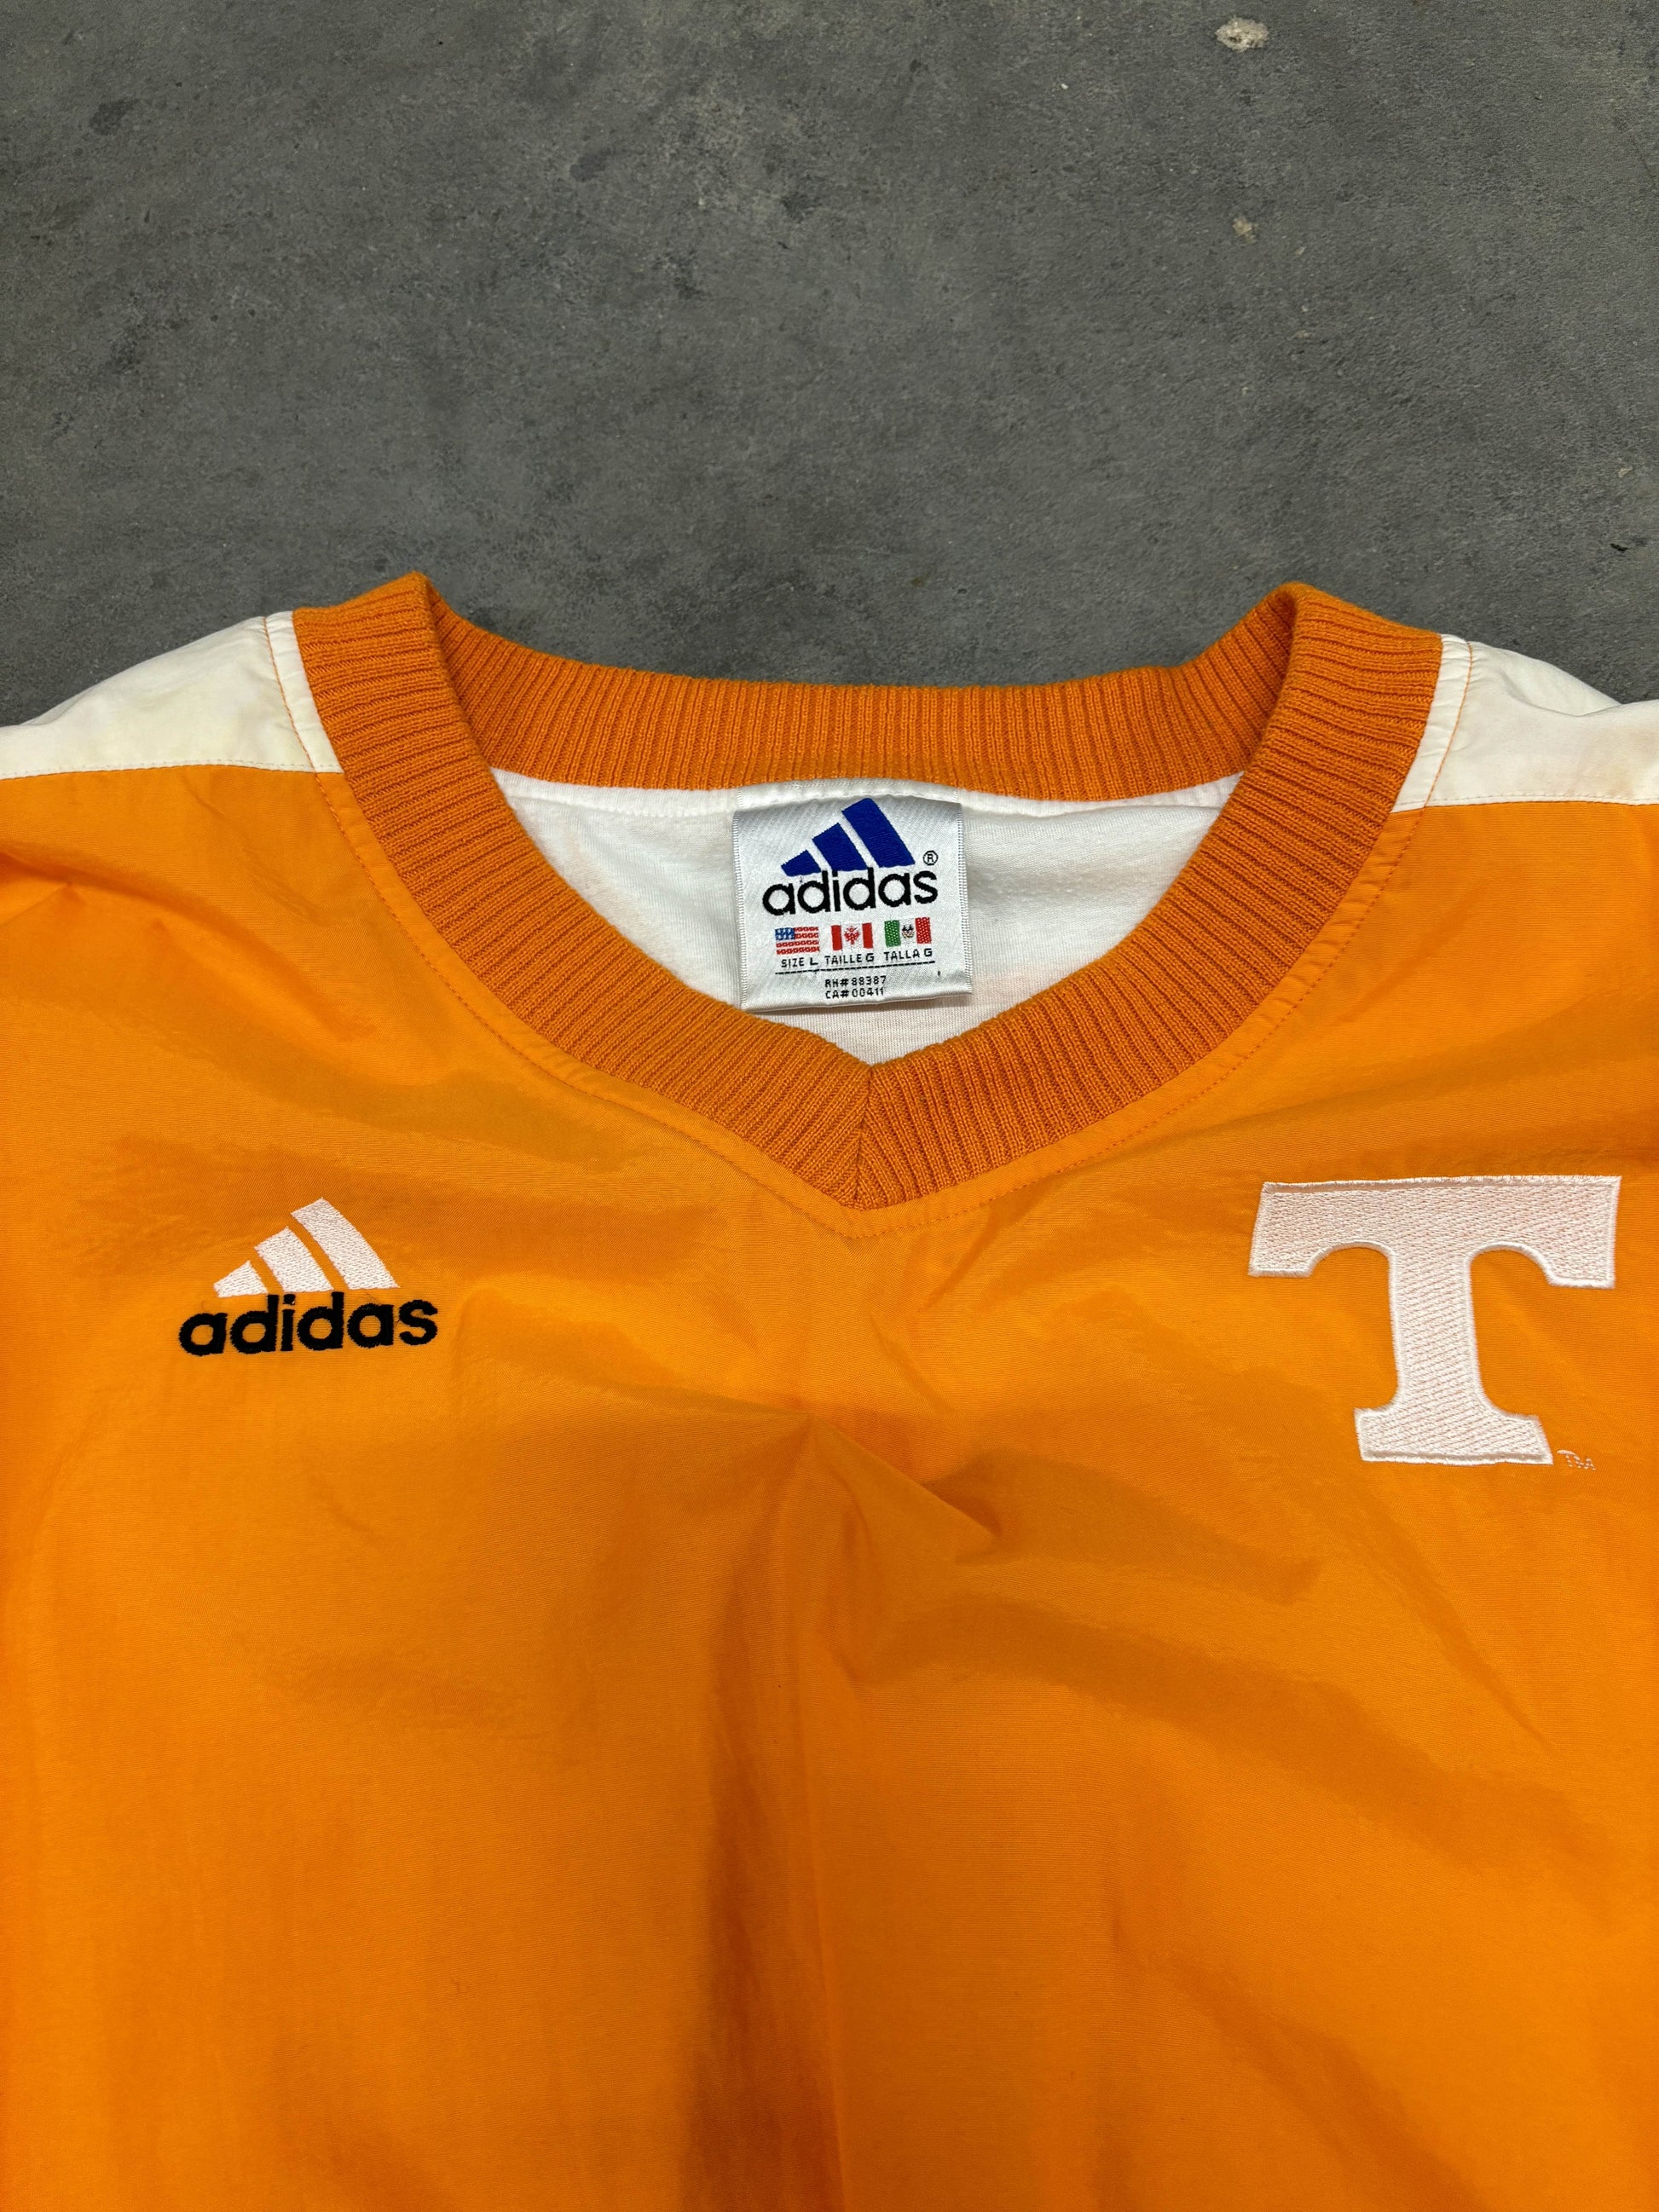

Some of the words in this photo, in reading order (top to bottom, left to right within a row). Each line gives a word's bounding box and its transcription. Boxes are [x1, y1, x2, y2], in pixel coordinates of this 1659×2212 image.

[762, 867, 938, 915] adidas
[781, 957, 805, 968] SIZE
[809, 956, 819, 967] L
[824, 954, 863, 965] TAILLE
[865, 952, 875, 963] G
[884, 949, 920, 961] TALLA
[923, 948, 934, 958] G
[178, 1291, 438, 1356] adidas
[1248, 1175, 1621, 1465] T
